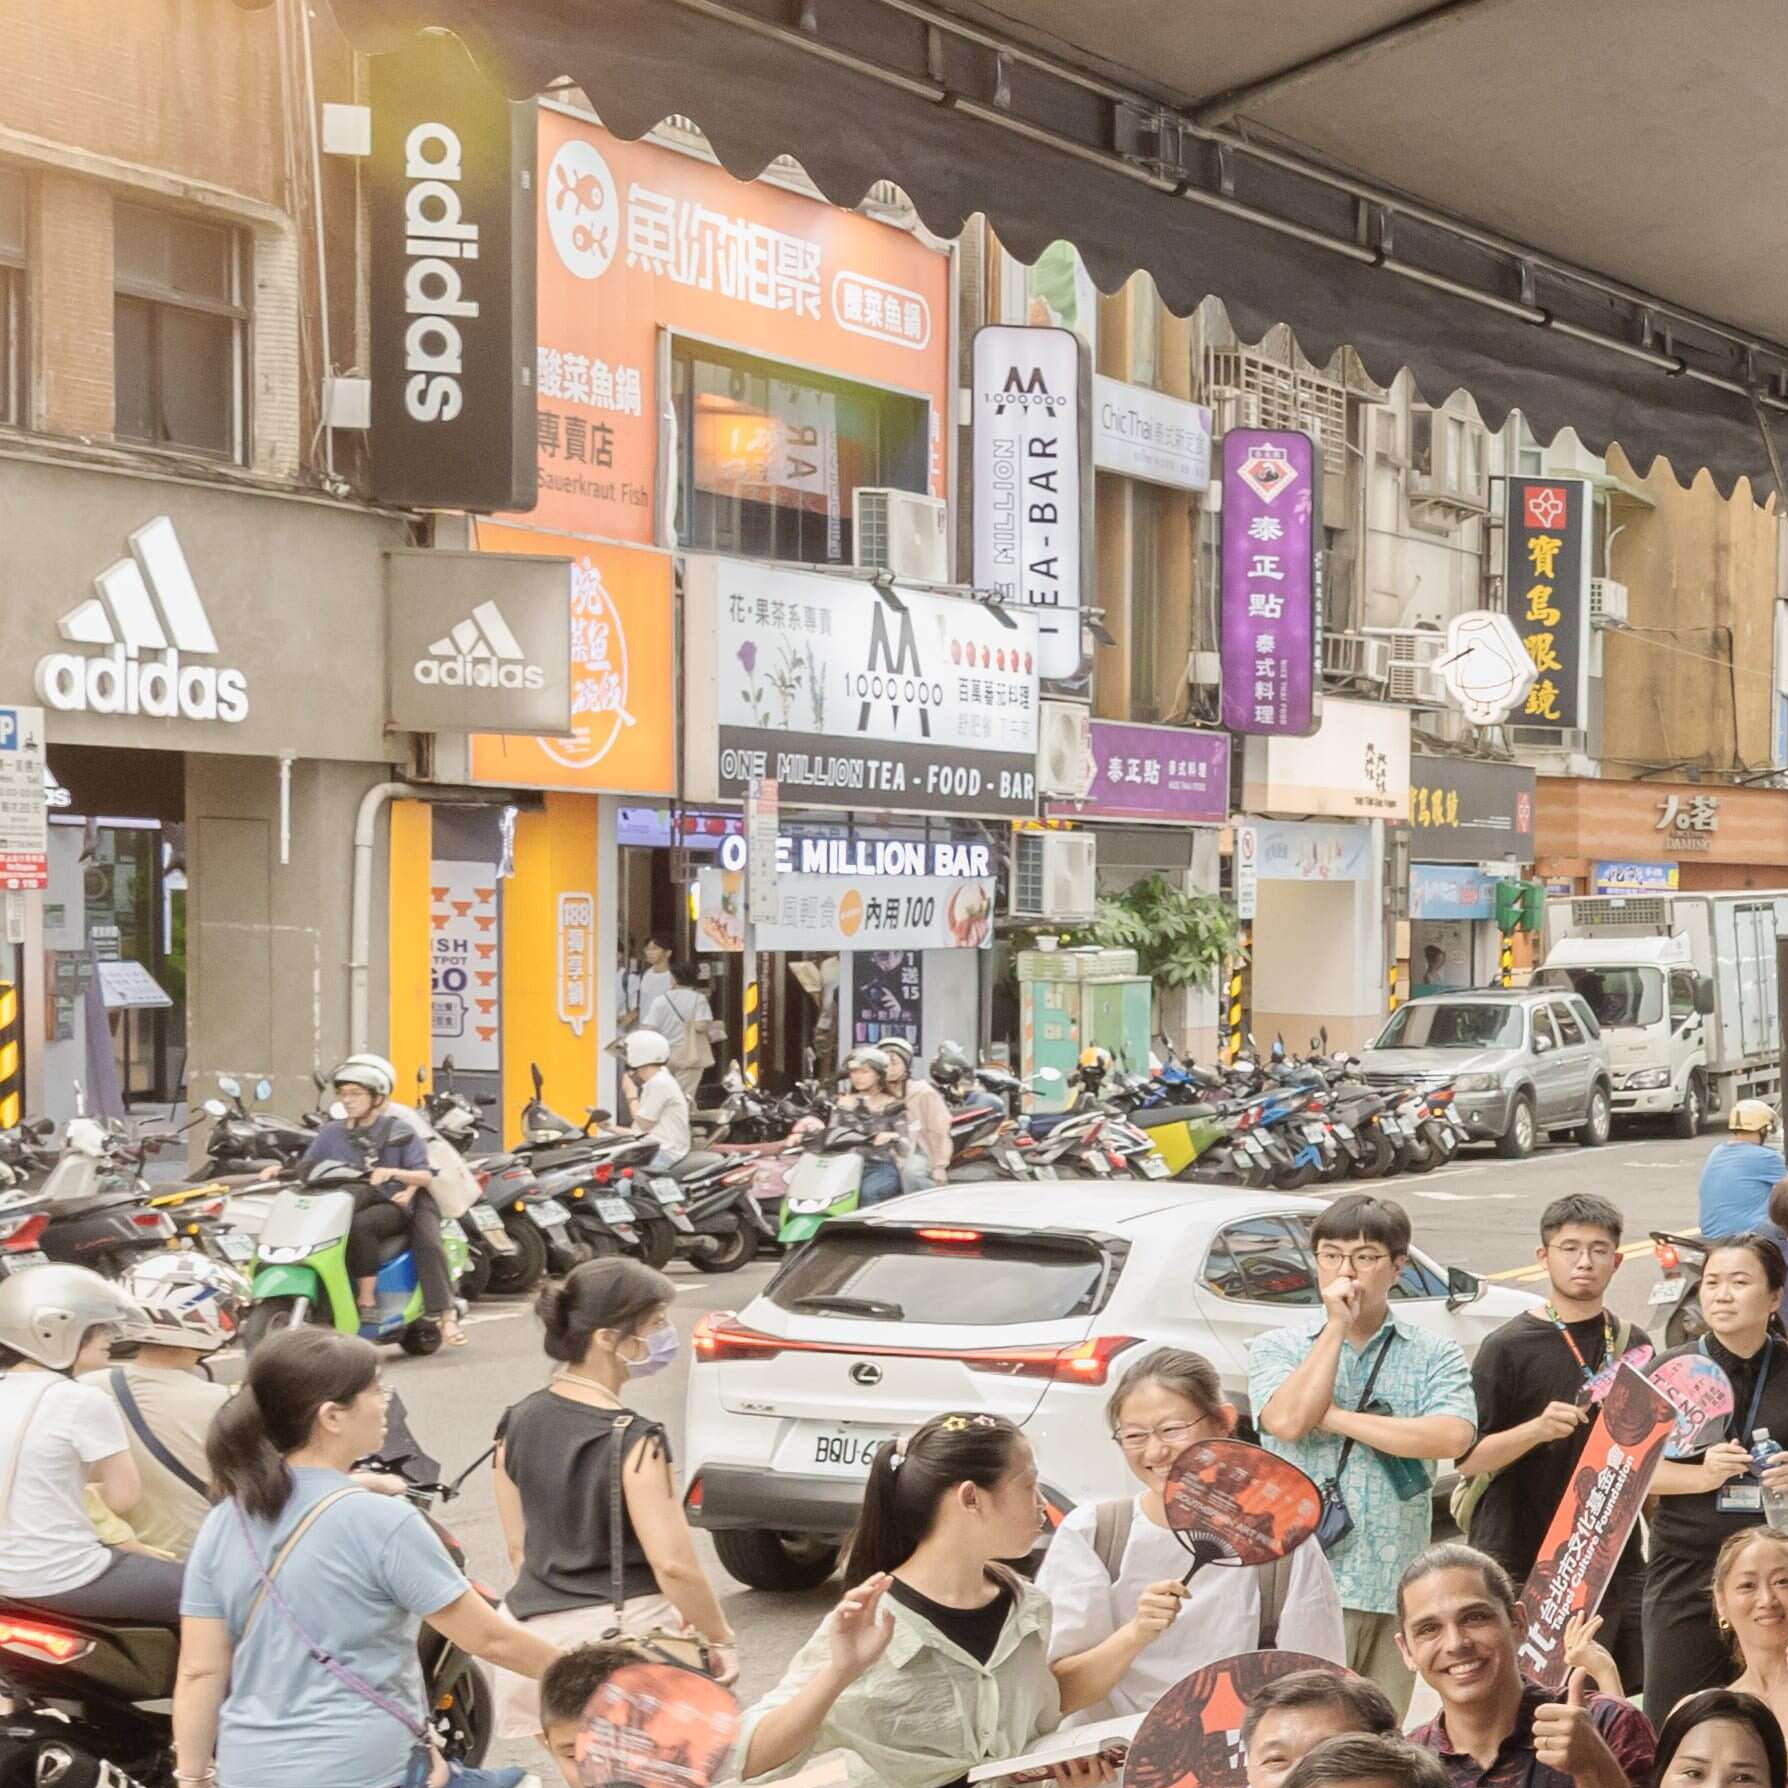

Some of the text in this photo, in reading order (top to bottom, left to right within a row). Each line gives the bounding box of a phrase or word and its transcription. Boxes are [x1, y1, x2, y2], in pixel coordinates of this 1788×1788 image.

[405, 122, 479, 423] adidas
[626, 182, 822, 321] 魚你相聚
[536, 347, 642, 417] 酸菜魚鍋
[537, 412, 614, 469] 專賣店
[1248, 516, 1285, 620] 泰正點
[1525, 535, 1563, 721] 寶島眼鏡
[35, 643, 250, 724] adidas
[414, 653, 545, 690] adidas
[1254, 635, 1276, 726] 泰式料理
[721, 749, 769, 781] ONE
[868, 759, 907, 791] TEA
[927, 765, 982, 797] FOOD
[999, 770, 1034, 801] BAR
[721, 836, 989, 878] OE MILLION BAR
[865, 896, 934, 931] 內用 100
[815, 1436, 877, 1465] BQU-6
[1540, 1443, 1626, 1625] 台北市文化基金會
[1551, 1454, 1635, 1631] Taipei Culture Foundation
